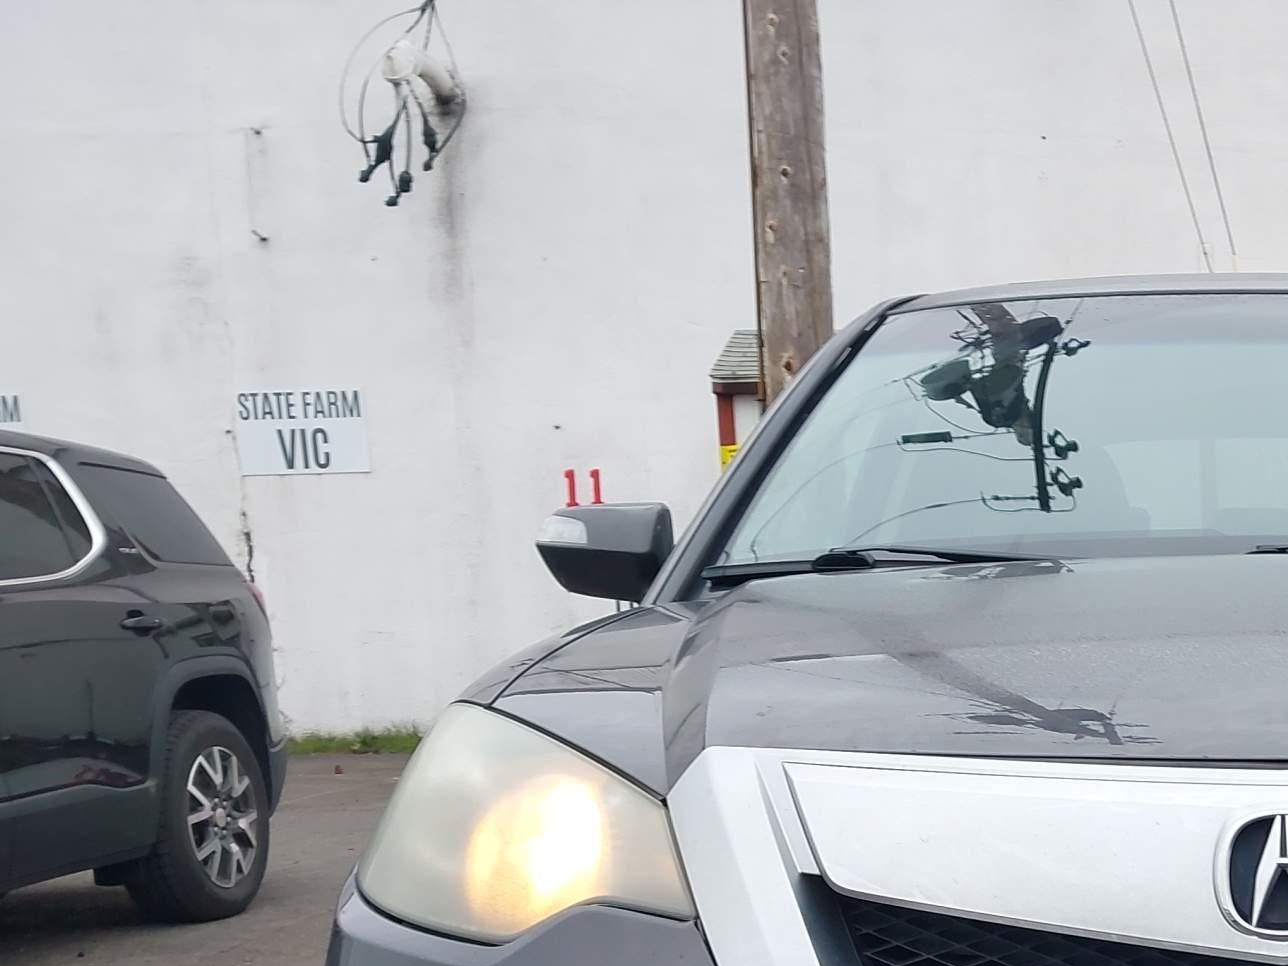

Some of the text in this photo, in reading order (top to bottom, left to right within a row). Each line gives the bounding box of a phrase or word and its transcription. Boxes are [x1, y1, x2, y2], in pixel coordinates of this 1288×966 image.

[238, 390, 361, 420] STATE FARM
[276, 427, 331, 470] VIC
[564, 469, 604, 507] 11
